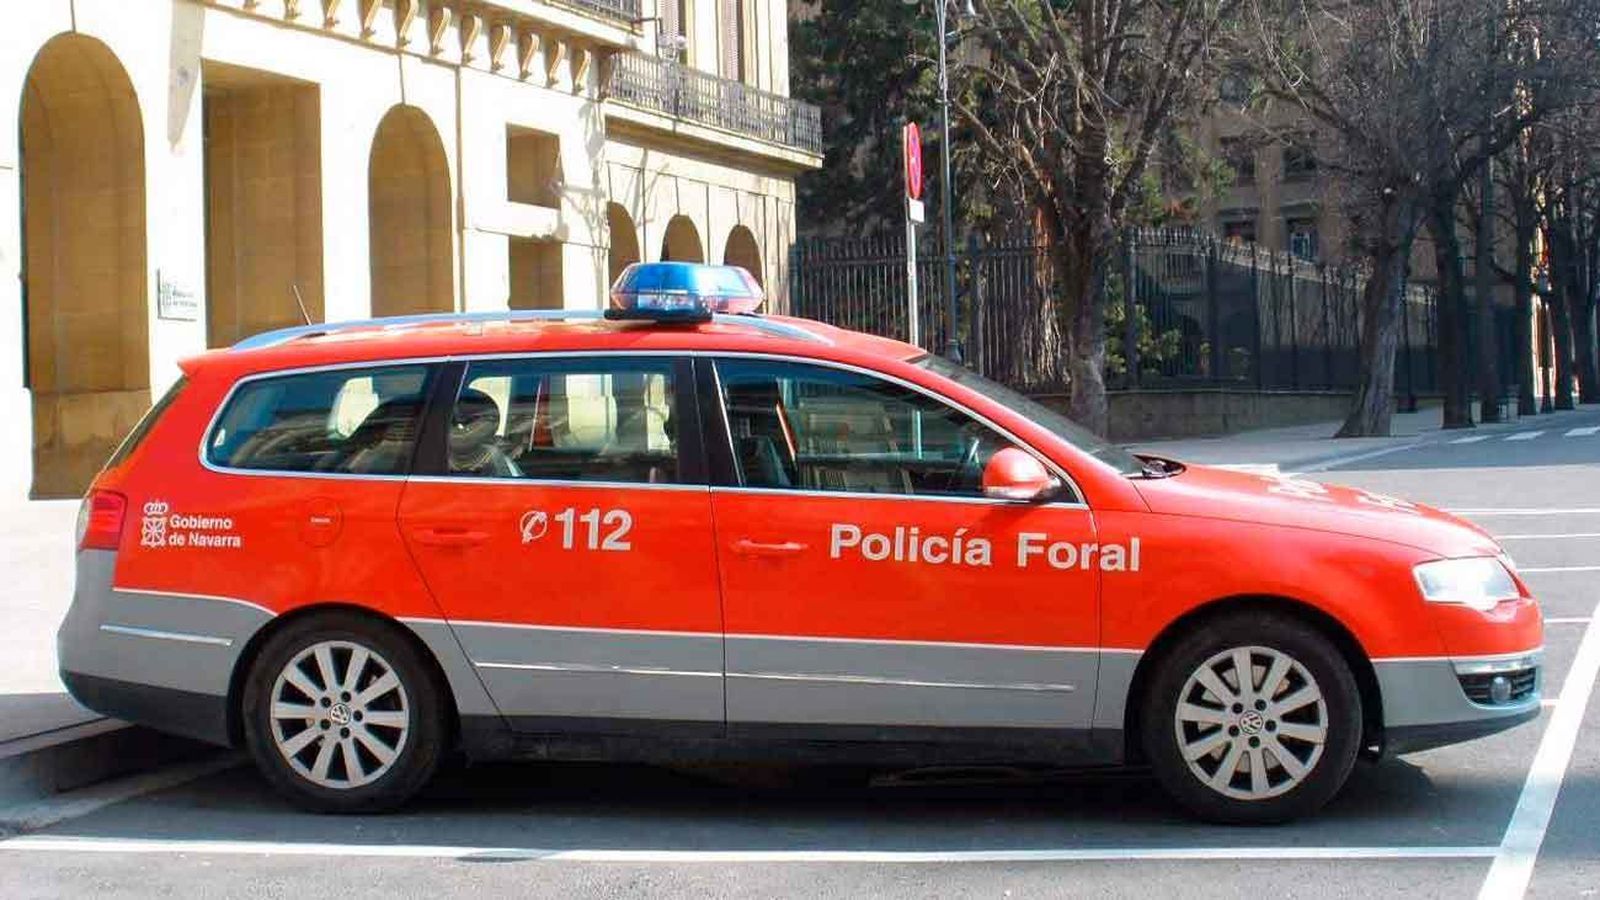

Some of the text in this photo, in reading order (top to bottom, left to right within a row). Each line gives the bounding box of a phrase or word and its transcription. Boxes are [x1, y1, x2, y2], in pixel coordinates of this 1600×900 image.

[170, 514, 233, 530] Gobierno
[555, 508, 632, 550] 112
[169, 532, 242, 548] de Navarra
[830, 523, 1140, 571] Policía Foral
